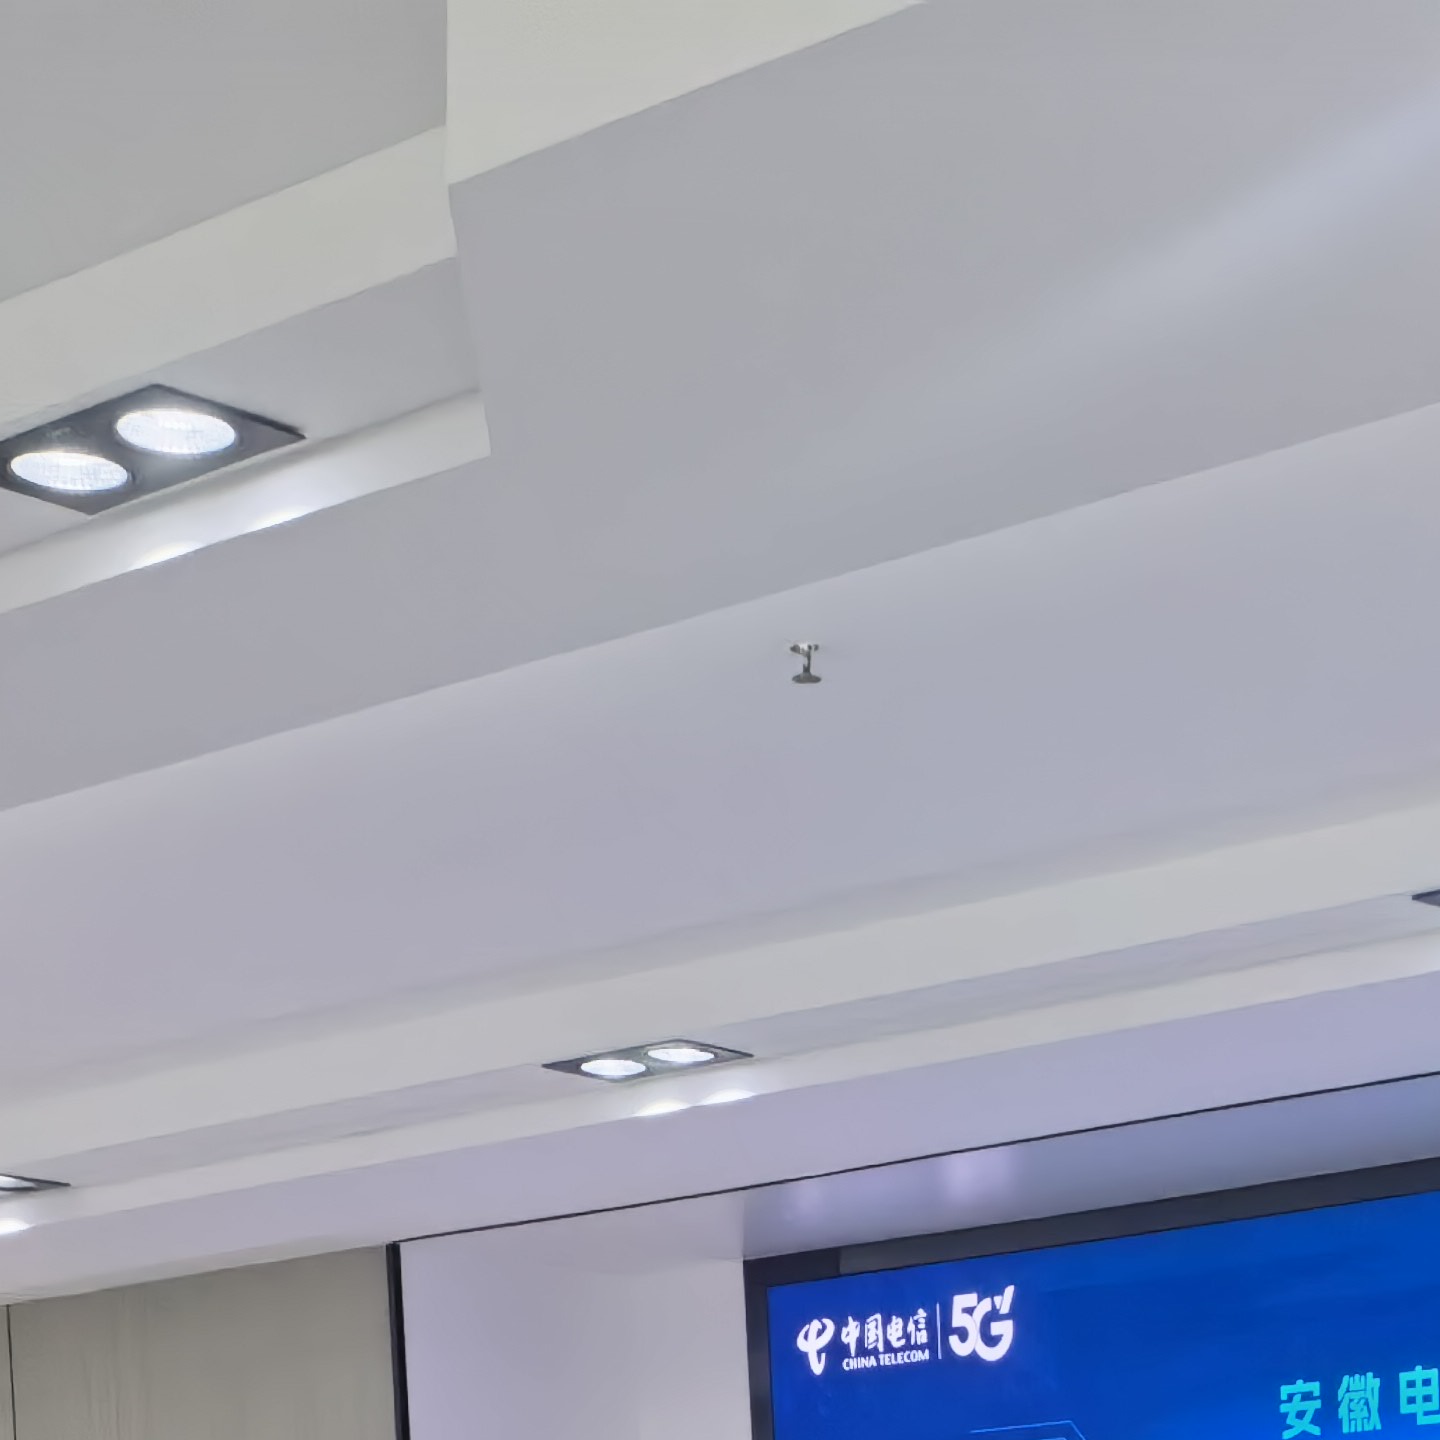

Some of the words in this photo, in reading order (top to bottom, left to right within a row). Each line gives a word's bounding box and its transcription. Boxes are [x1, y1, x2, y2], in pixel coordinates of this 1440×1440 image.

[841, 1308, 928, 1356] 中国电信
[949, 1285, 1015, 1361] 5G
[842, 1353, 877, 1371] CHINA
[878, 1349, 930, 1366] TELECOM
